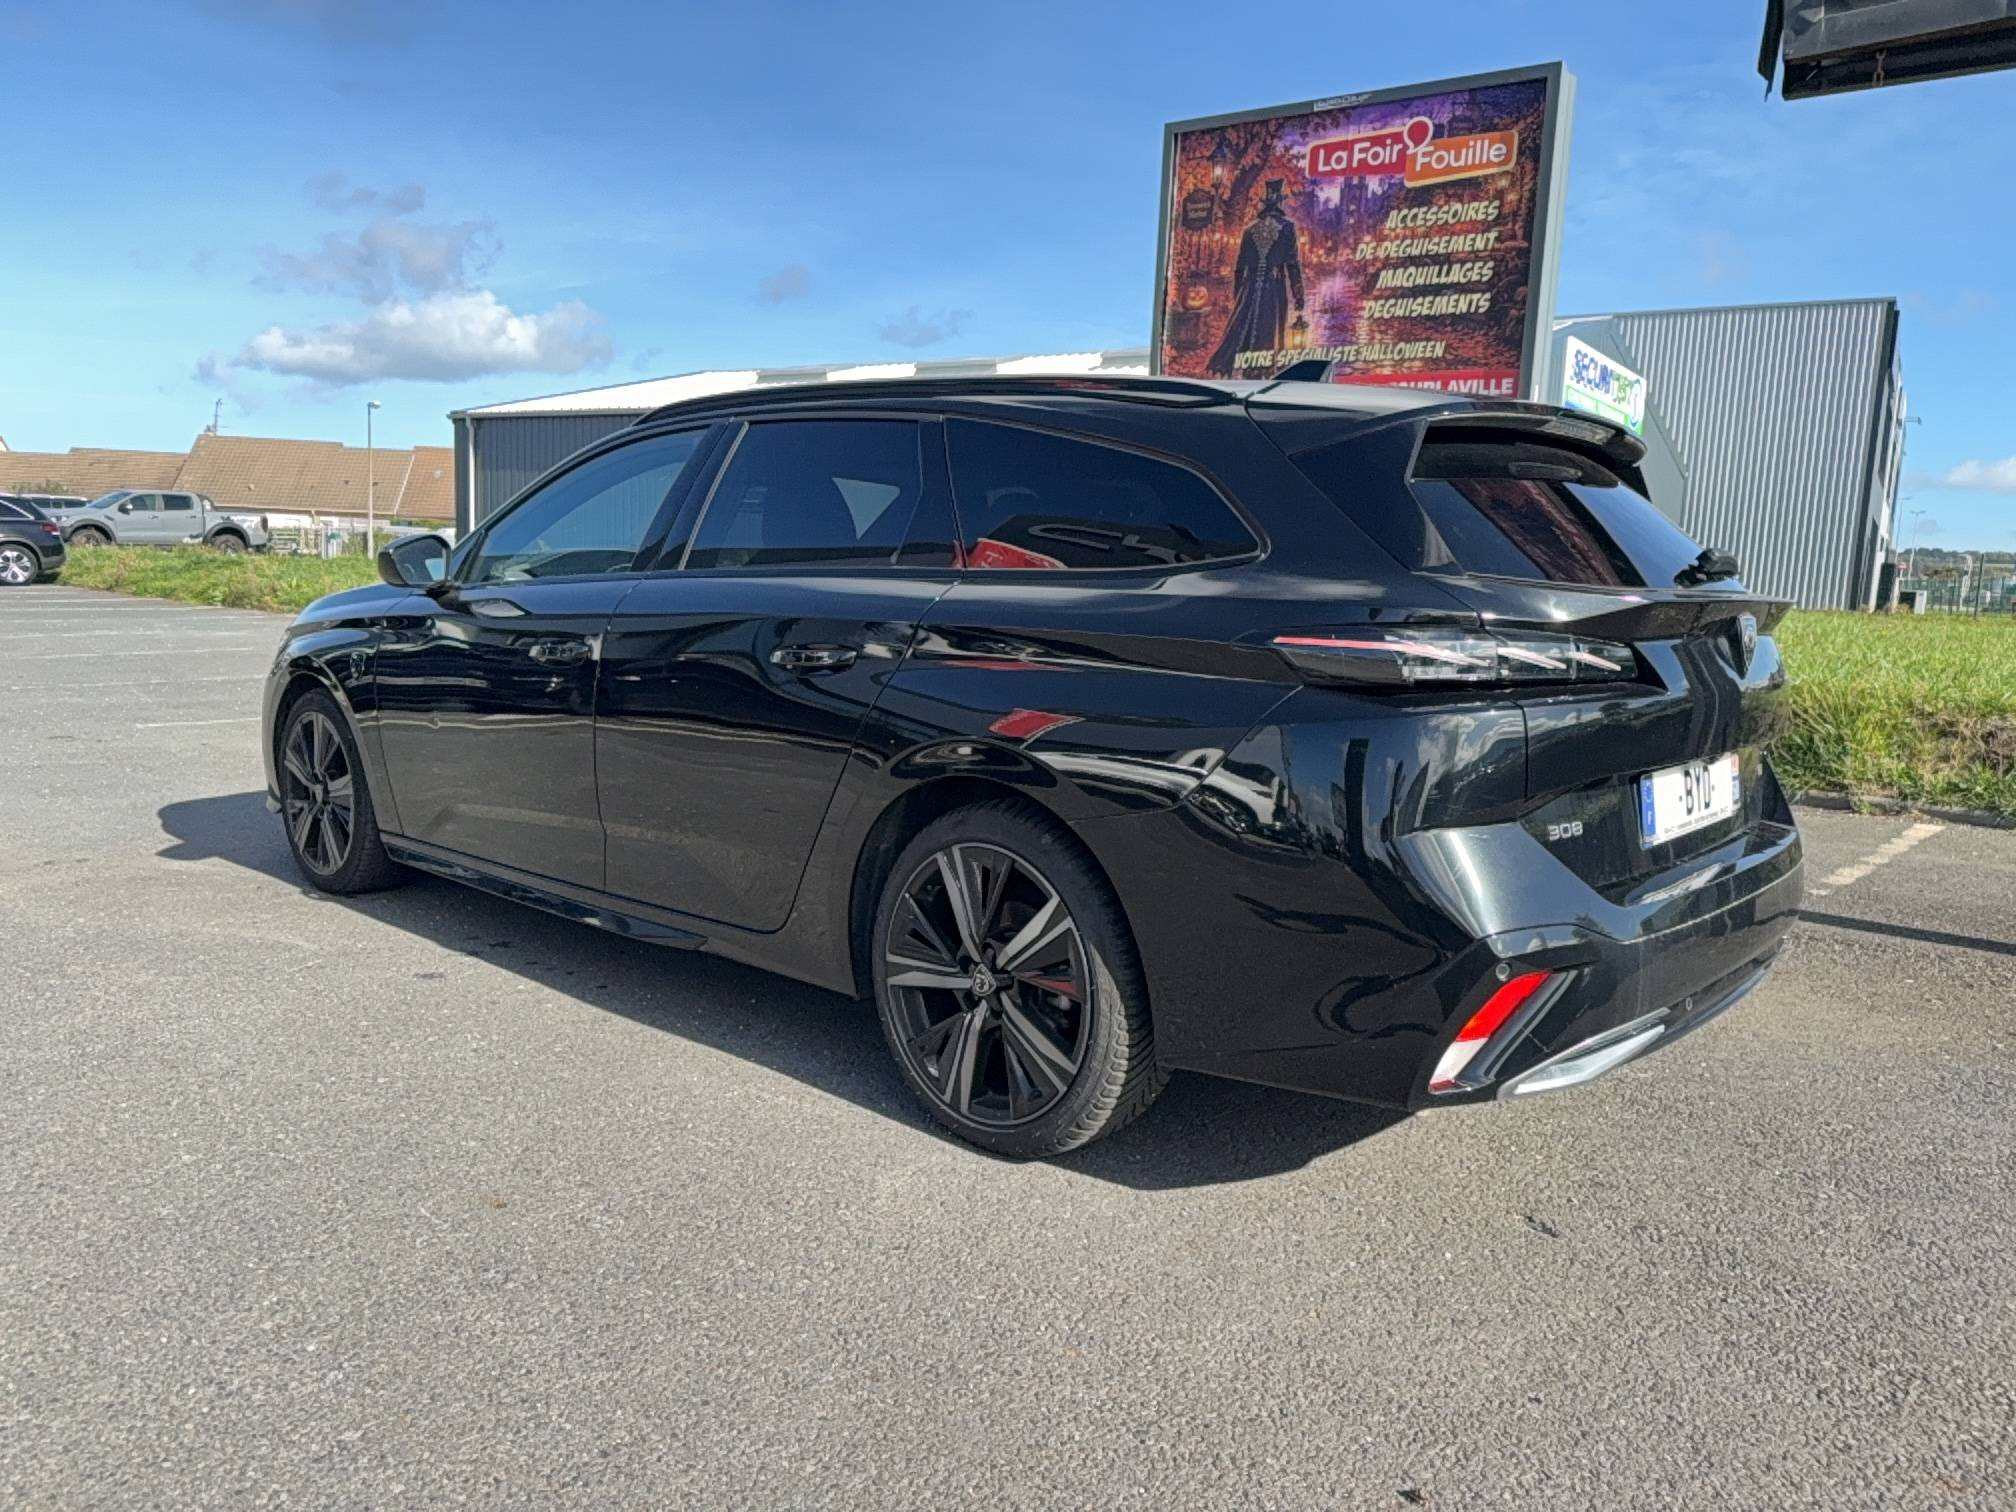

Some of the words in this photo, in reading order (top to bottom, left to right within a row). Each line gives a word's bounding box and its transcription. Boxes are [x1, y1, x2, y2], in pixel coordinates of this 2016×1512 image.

[1317, 148, 1347, 172] La
[1352, 138, 1403, 168] Foir
[1414, 139, 1507, 172] Fouille
[1386, 200, 1500, 229] ACCESSOIRES
[1356, 242, 1378, 260] DE
[1383, 232, 1498, 257] DEGUISEMENT
[1376, 261, 1494, 289] MAQUILLAGES
[1364, 292, 1491, 318] DEGUISEMENTS
[1234, 351, 1274, 369] VOTRE
[1361, 341, 1446, 361] HALLOWEEN
[1548, 821, 1584, 840] 308
